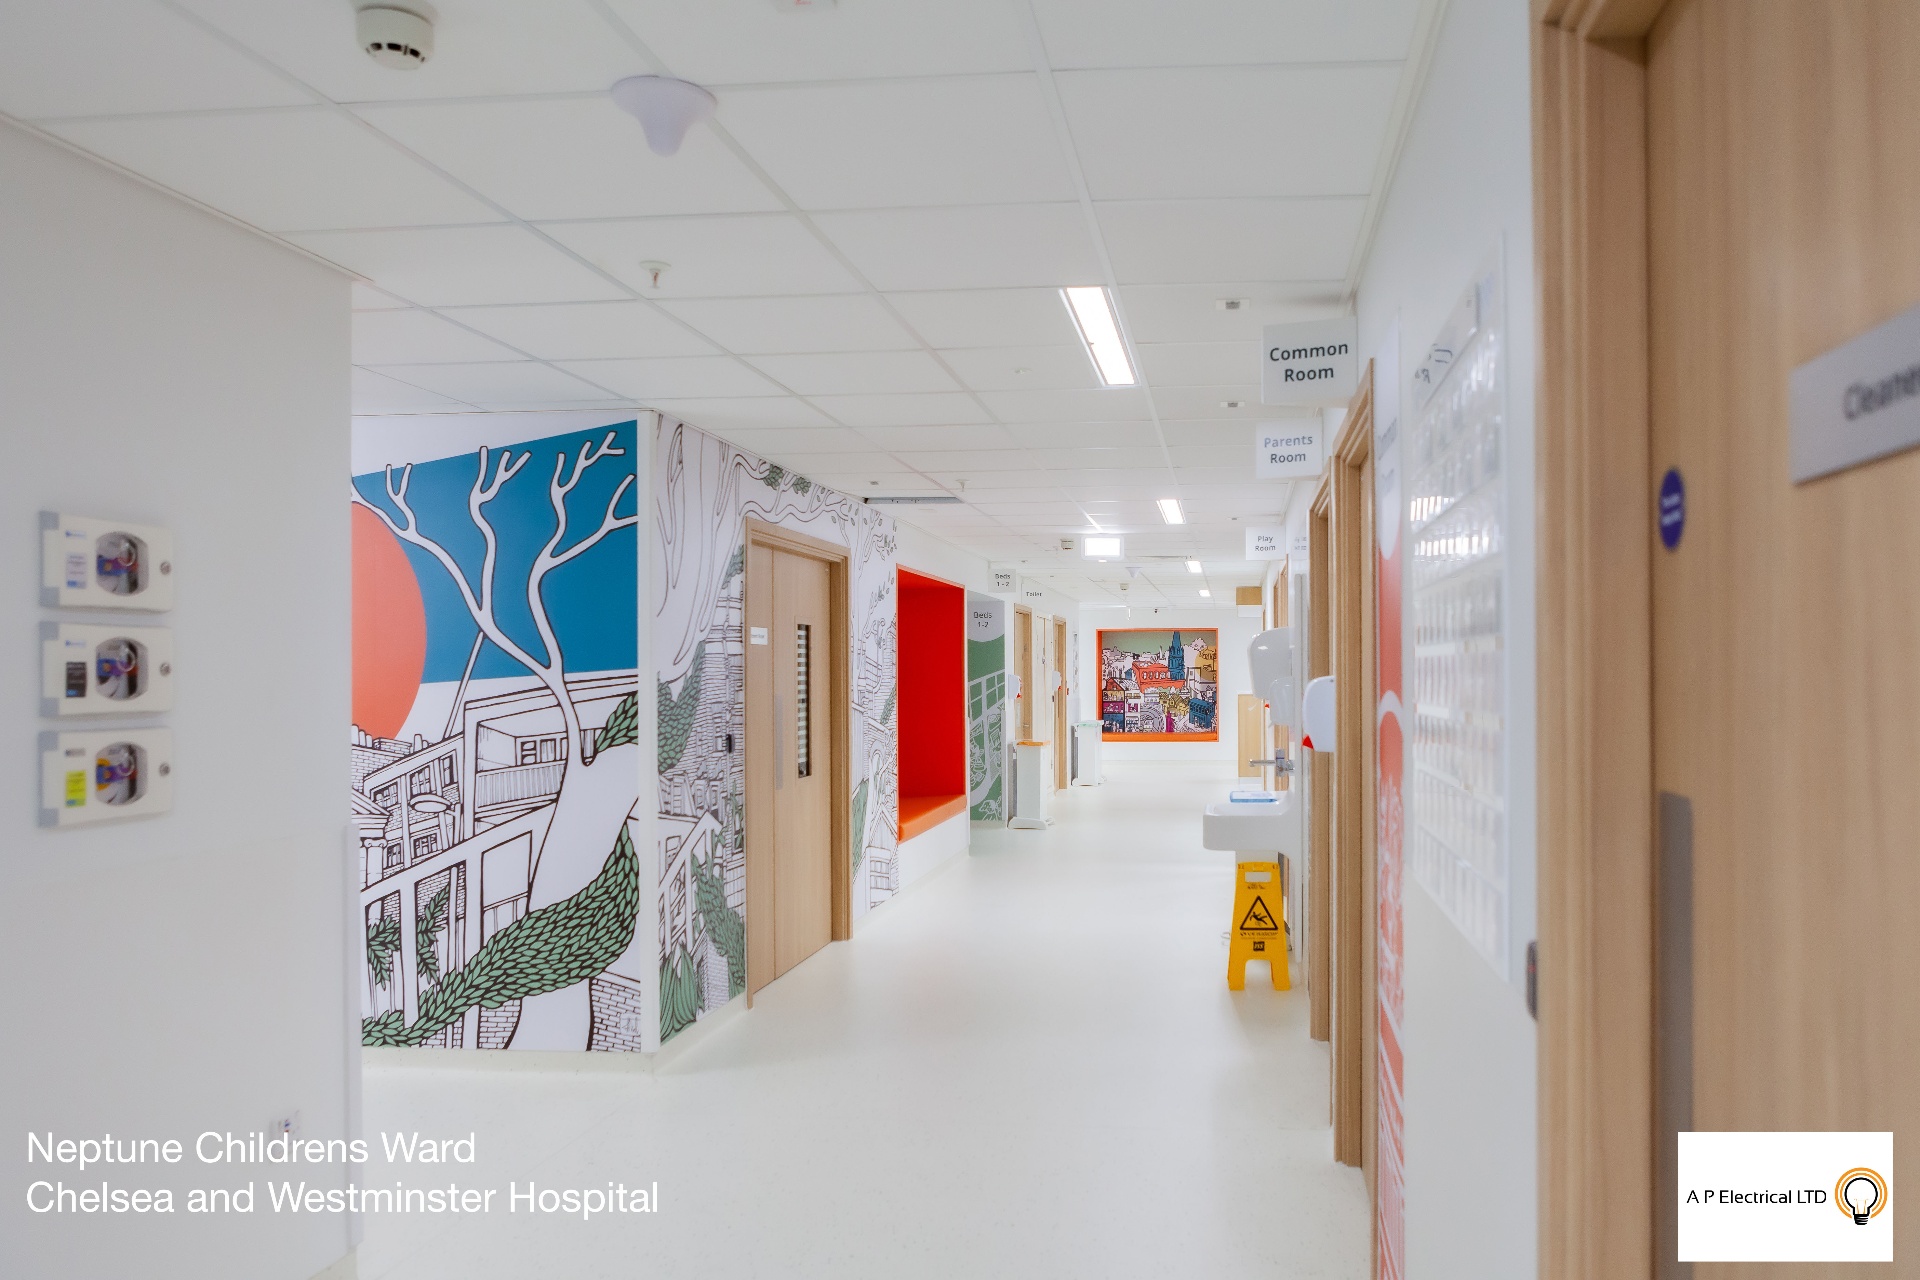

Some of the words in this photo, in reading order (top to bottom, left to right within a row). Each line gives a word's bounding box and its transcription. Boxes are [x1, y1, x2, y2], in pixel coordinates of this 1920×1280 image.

[1269, 342, 1349, 362] Common
[1284, 366, 1335, 382] Room
[1264, 434, 1314, 448] Parents
[1269, 453, 1306, 464] Room
[1257, 535, 1274, 543] Play
[973, 611, 993, 619] Beds
